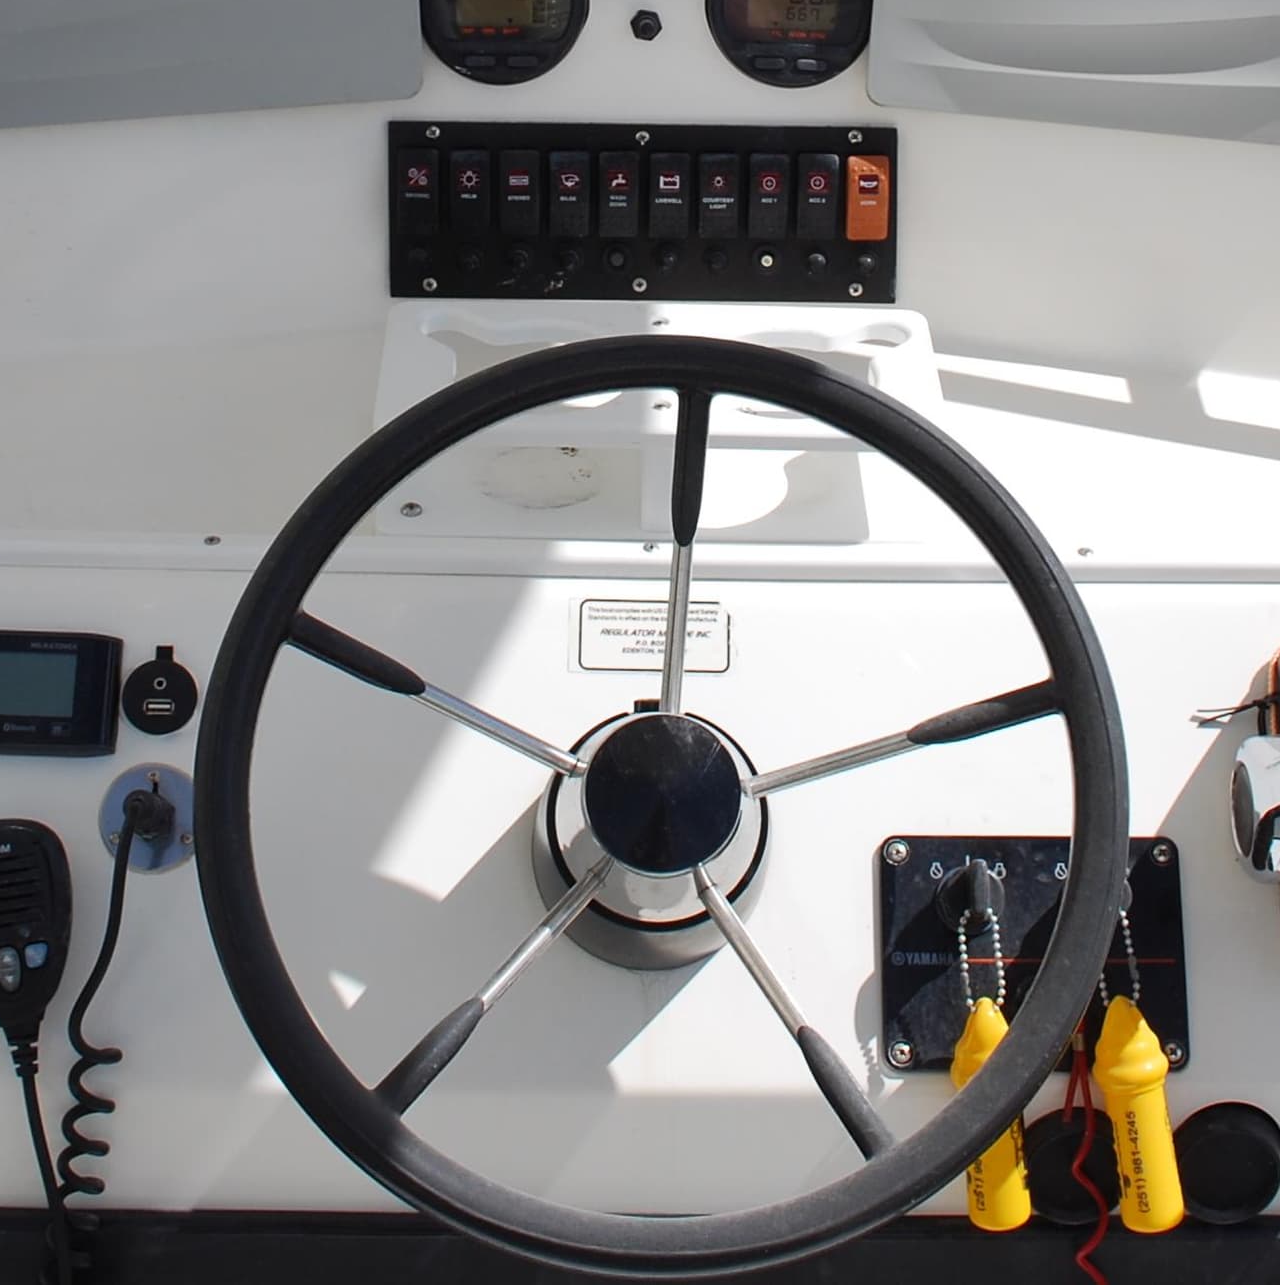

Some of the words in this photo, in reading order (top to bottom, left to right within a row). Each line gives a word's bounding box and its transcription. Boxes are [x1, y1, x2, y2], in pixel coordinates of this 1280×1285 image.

[905, 951, 954, 966] YAMAHA
[1124, 1110, 1143, 1175] 981-4245
[1133, 1178, 1151, 1214] (251)
